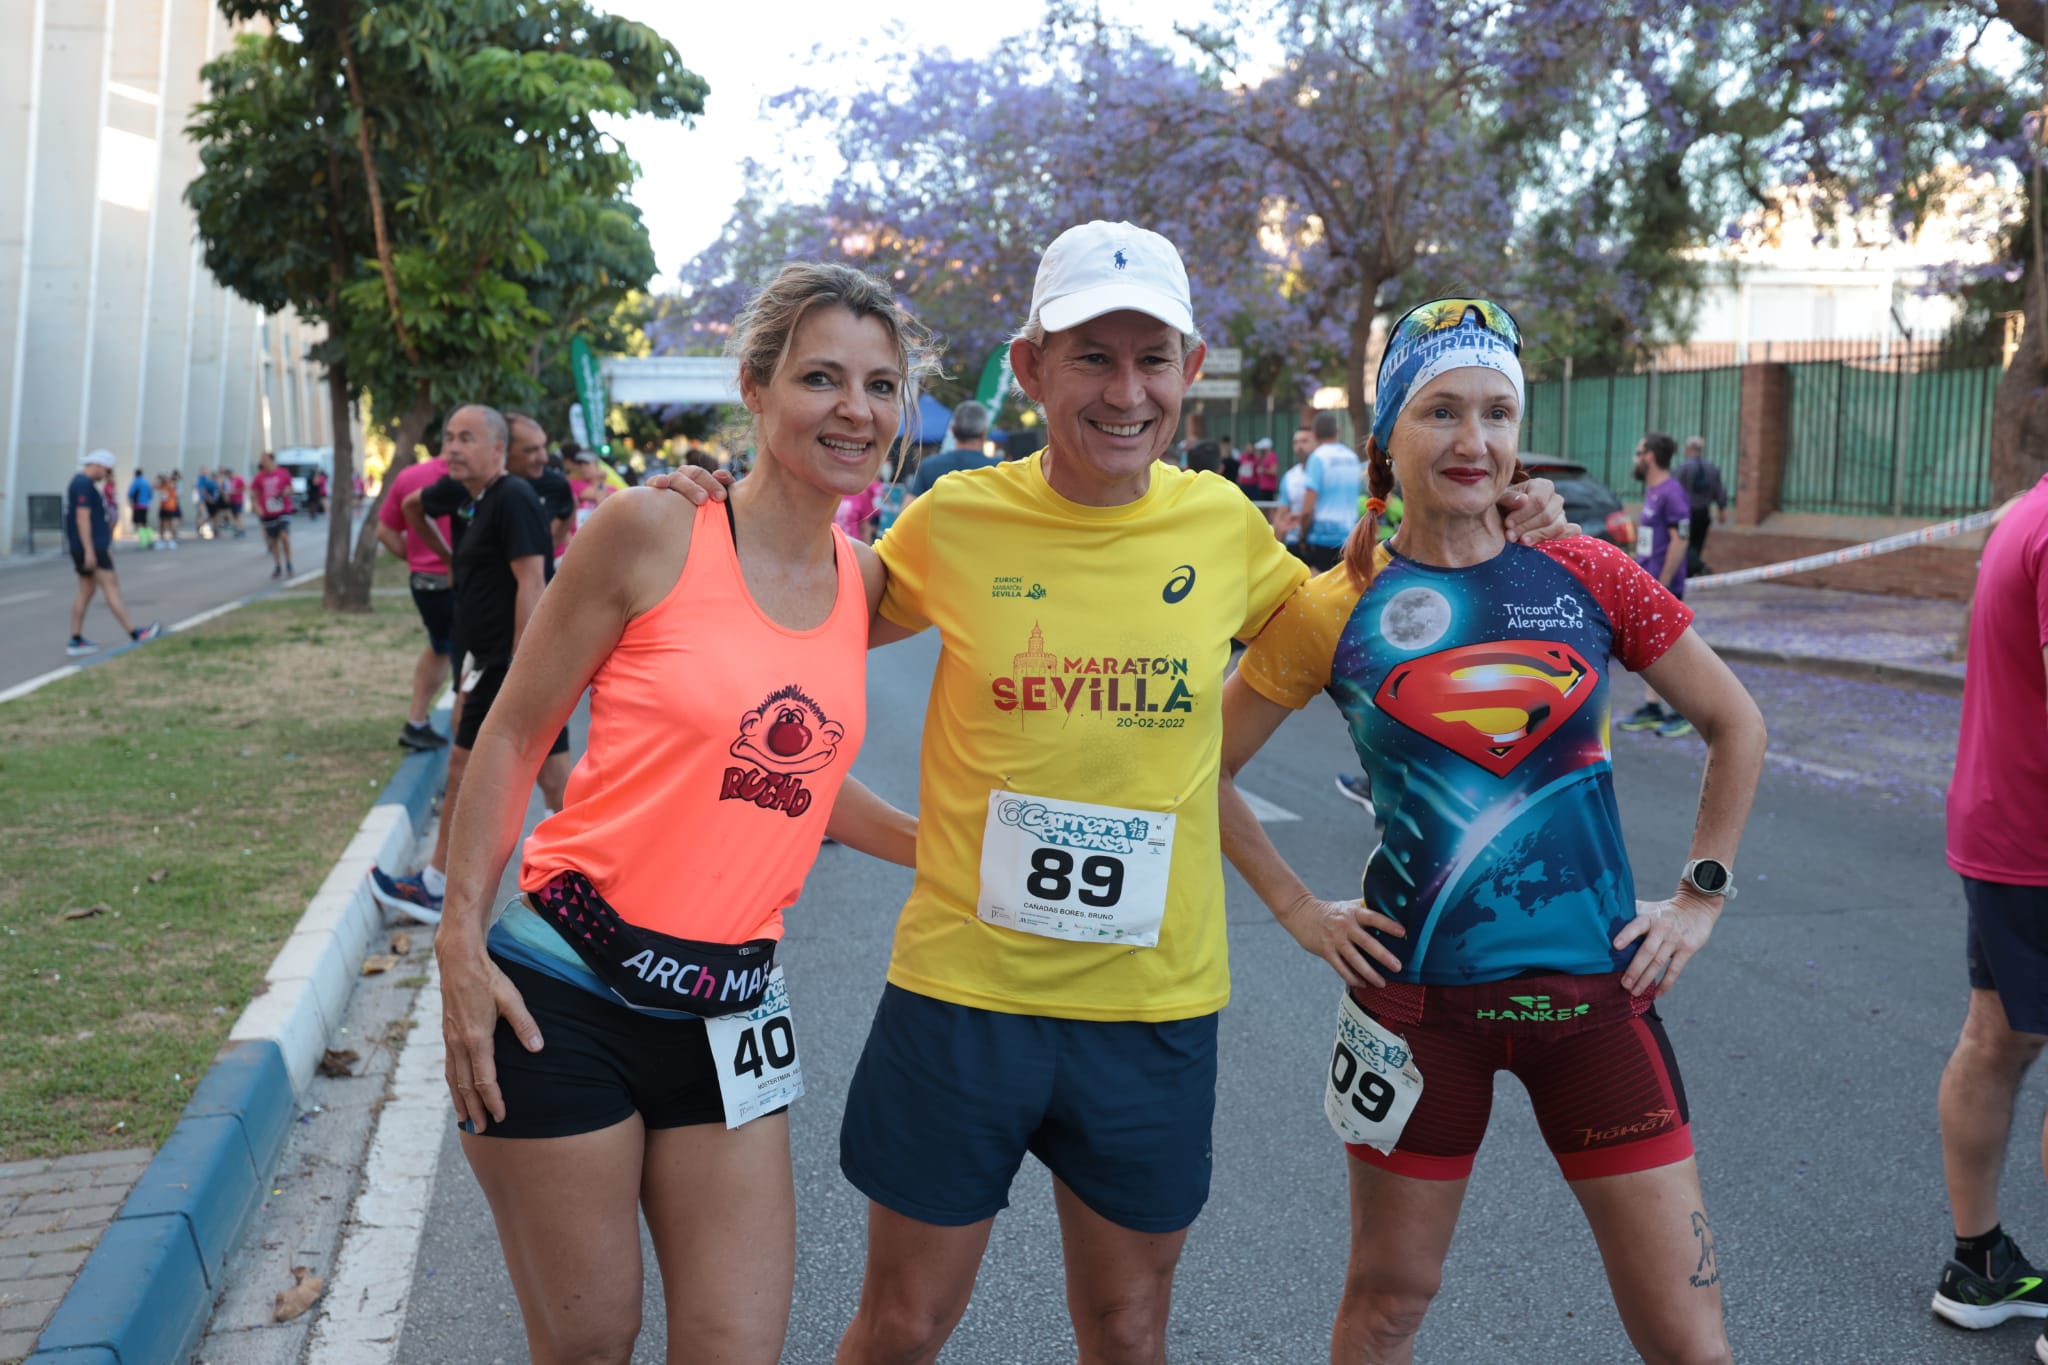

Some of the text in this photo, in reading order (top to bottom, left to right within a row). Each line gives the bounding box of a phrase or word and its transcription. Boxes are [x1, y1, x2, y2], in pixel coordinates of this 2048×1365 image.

[1503, 603, 1560, 615] Tricouri
[1507, 615, 1584, 631] Alergare.ro
[1116, 717, 1185, 728] 20-02-2022
[1021, 803, 1127, 837] Carrera
[1128, 818, 1147, 831] de
[1041, 826, 1133, 853] Prensa
[1027, 848, 1125, 907] 89
[1088, 912, 1115, 921] BRUNO
[621, 949, 716, 999] ARCh
[734, 1015, 796, 1079] 40
[1332, 1041, 1395, 1123] 09
